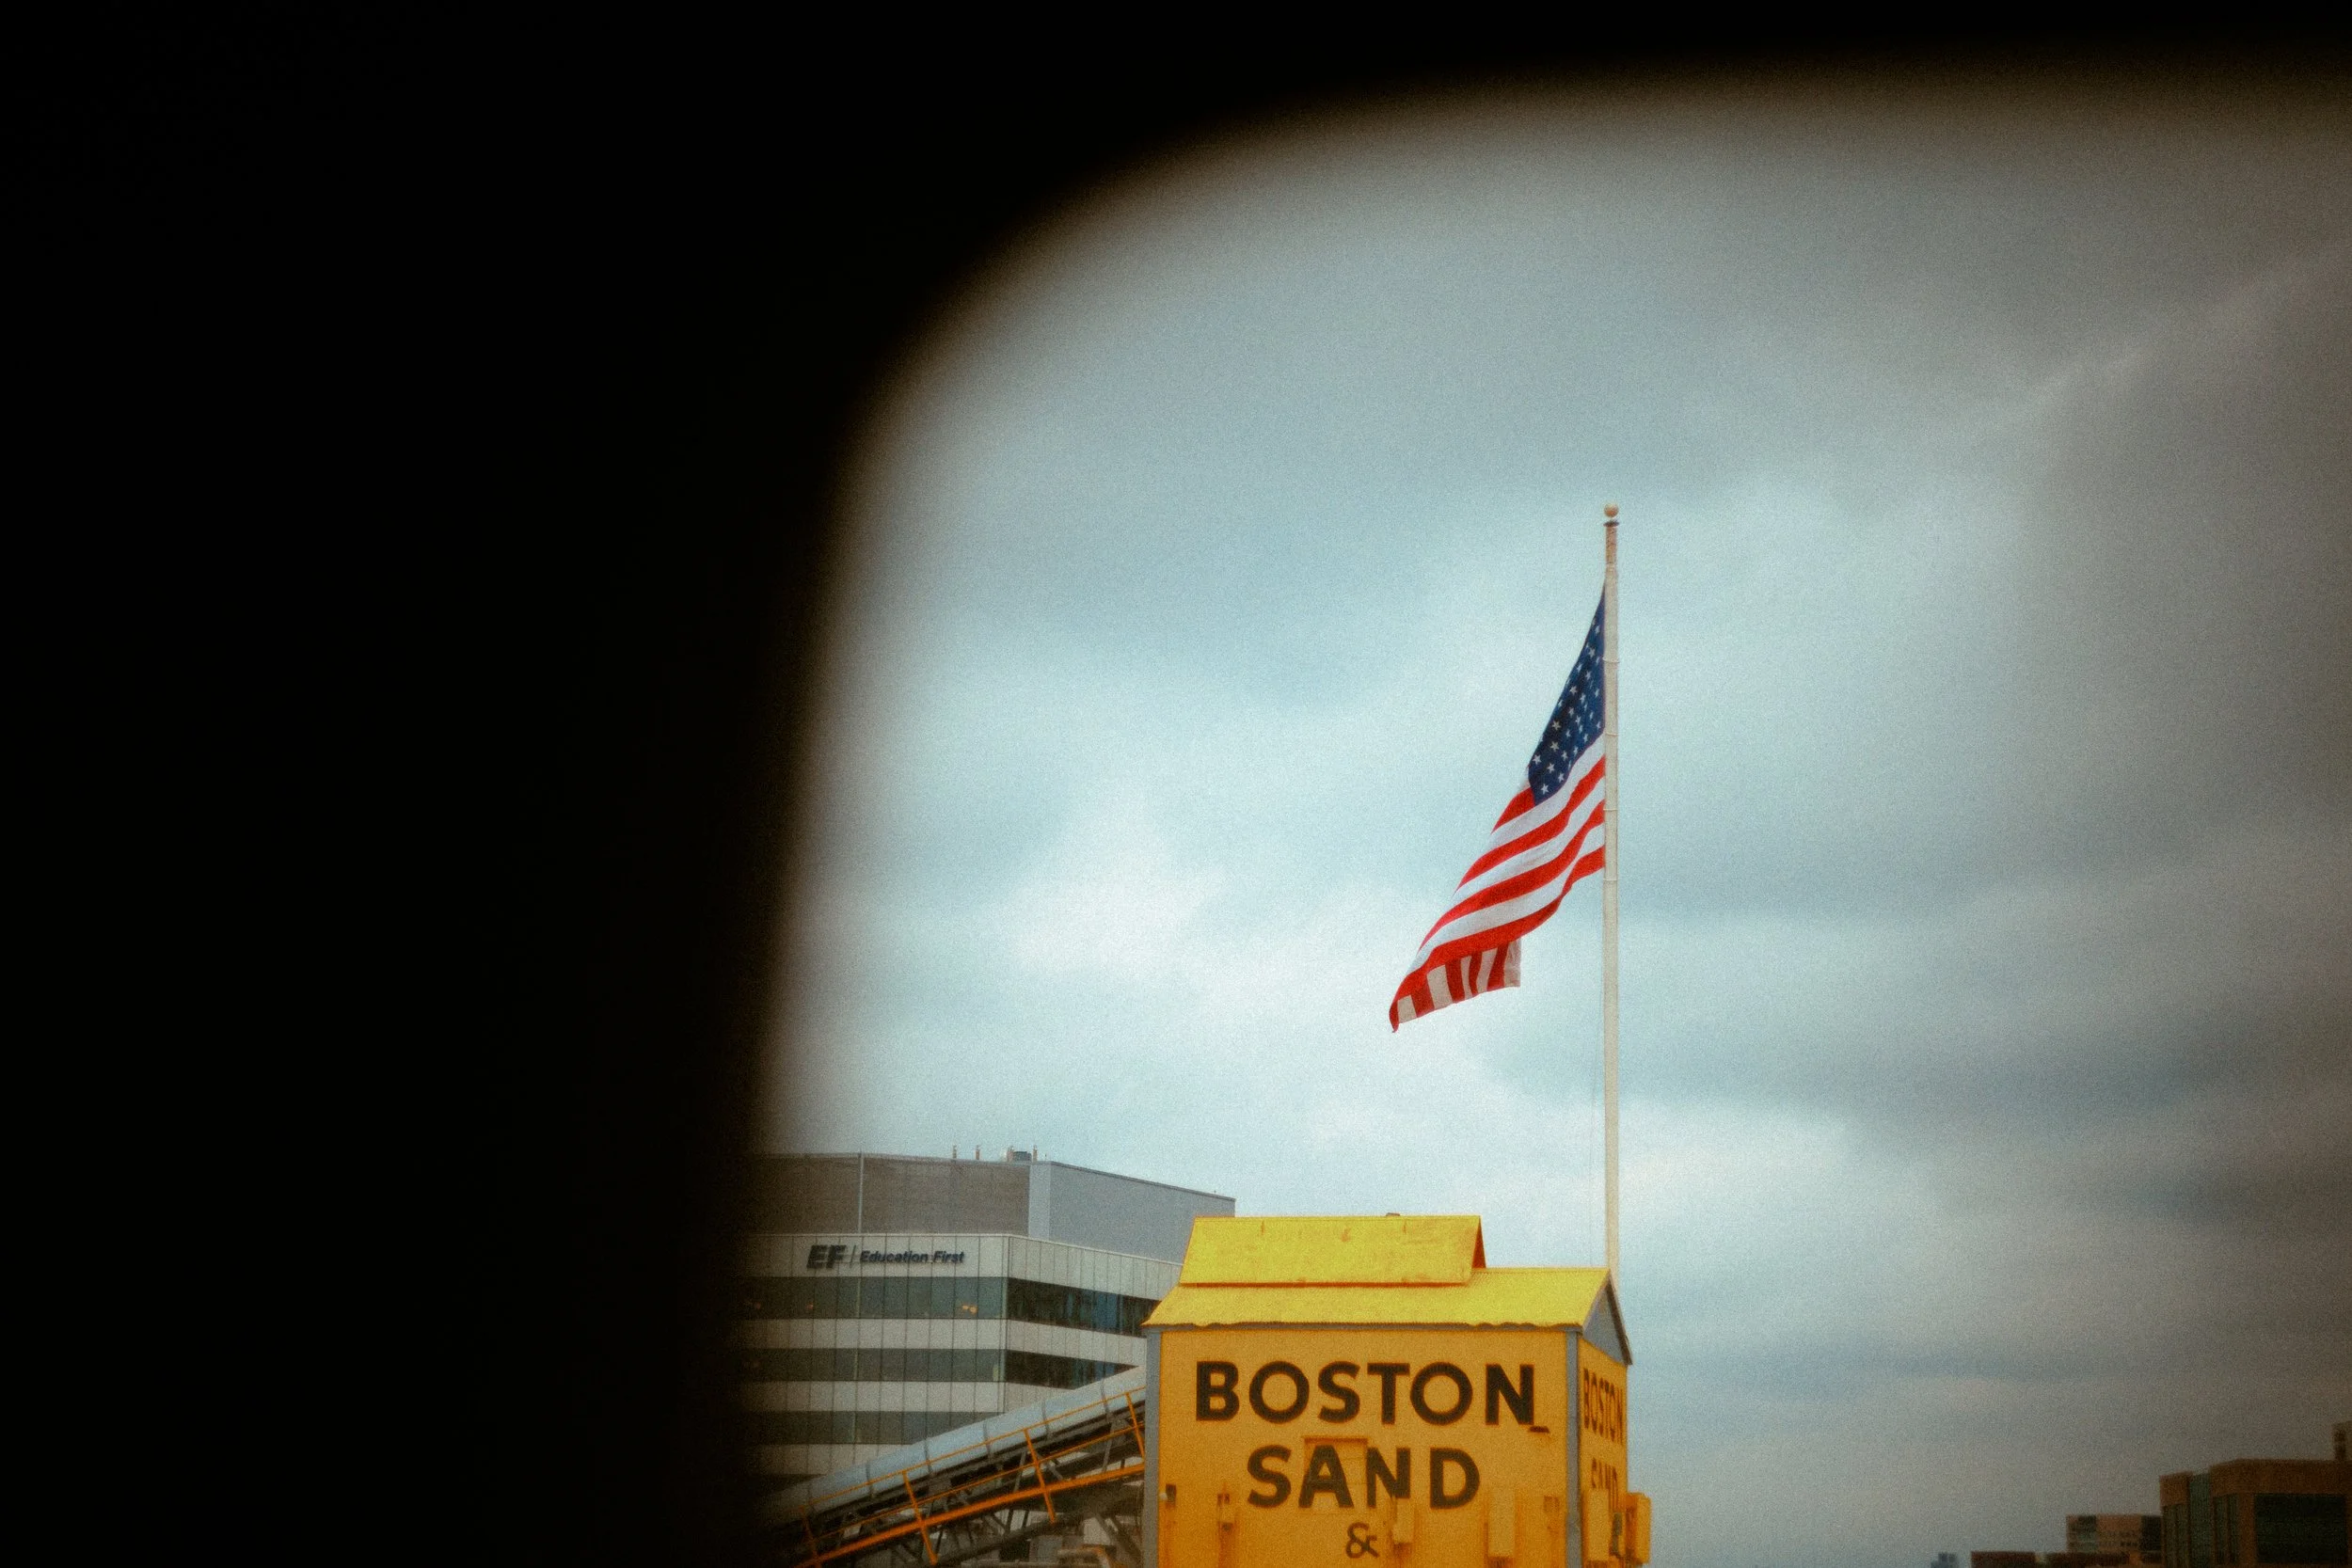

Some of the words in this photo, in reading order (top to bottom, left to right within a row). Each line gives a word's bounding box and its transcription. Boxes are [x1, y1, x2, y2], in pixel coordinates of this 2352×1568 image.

[806, 1244, 847, 1269] EF
[861, 1250, 928, 1263] Education
[932, 1250, 965, 1263] First
[1196, 1361, 1535, 1426] BOSTON
[1583, 1368, 1624, 1446] BOSTON
[1247, 1445, 1481, 1509] SAND
[1345, 1522, 1379, 1559] &
